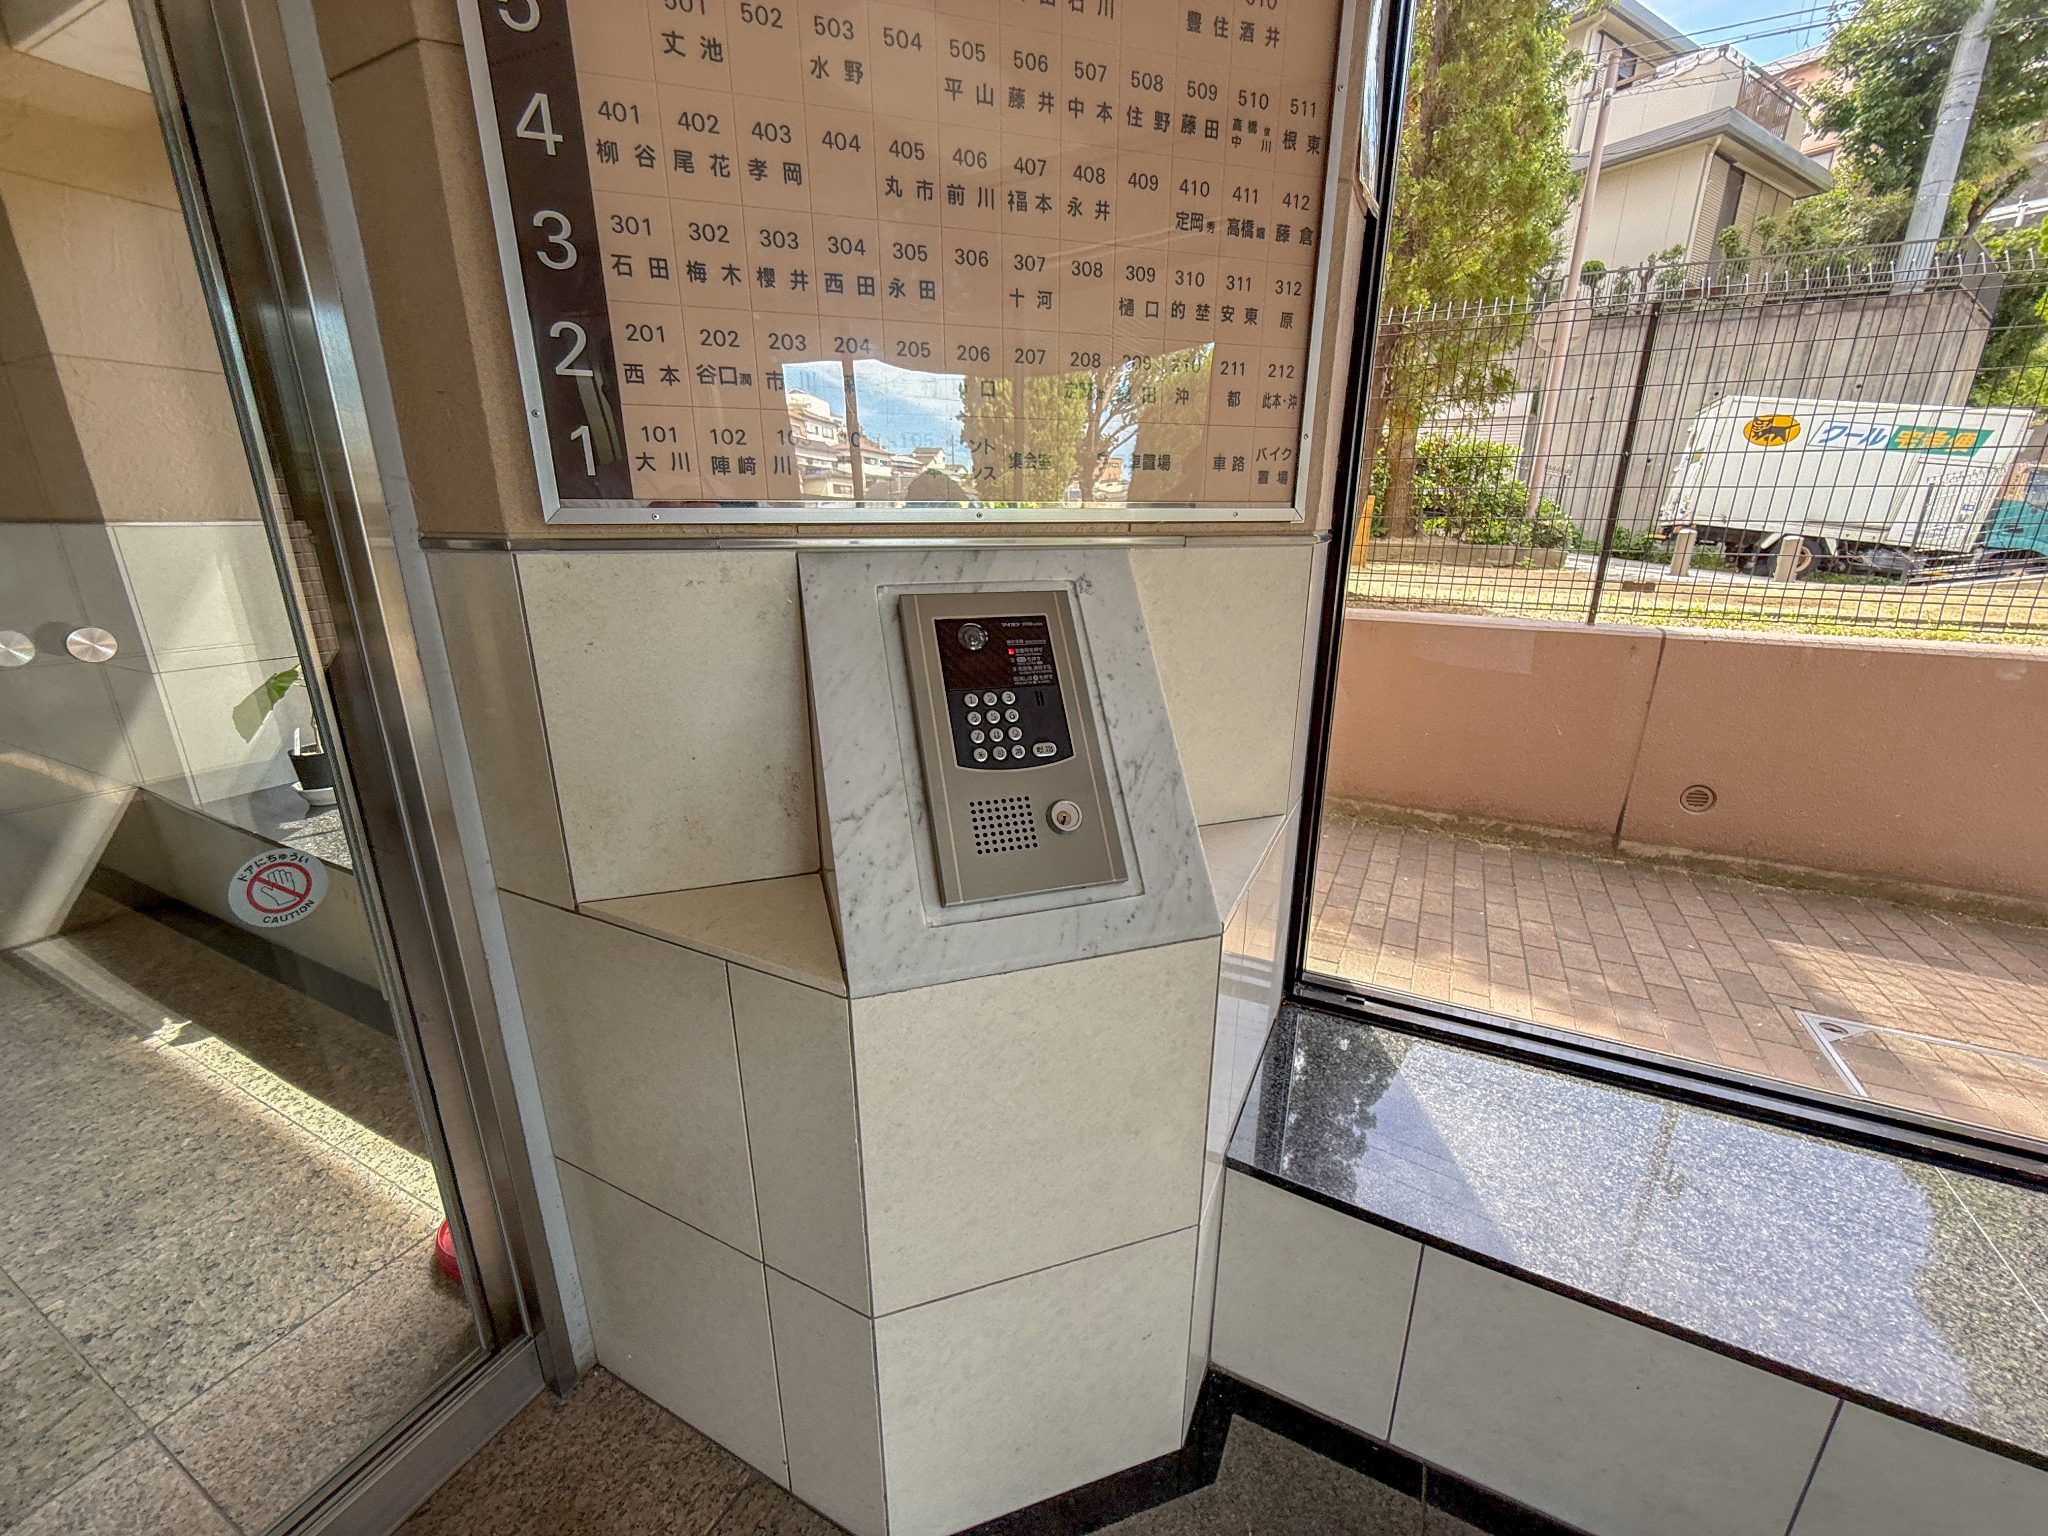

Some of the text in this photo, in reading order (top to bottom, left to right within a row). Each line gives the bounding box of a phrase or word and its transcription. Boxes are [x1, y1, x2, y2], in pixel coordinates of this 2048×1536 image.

[741, 3, 782, 28] 502
[814, 15, 854, 39] 503
[884, 27, 922, 51] 504
[950, 39, 985, 62] 505
[1014, 51, 1048, 72] 506
[1075, 61, 1106, 82] 507
[1132, 71, 1163, 92] 508
[1188, 81, 1217, 101] 509
[1239, 90, 1268, 110] 510
[1290, 99, 1315, 117] 511
[1240, 21, 1280, 48] 酒井
[515, 93, 563, 156] 4
[810, 56, 863, 84] 水野
[945, 78, 993, 106] 平山
[1008, 87, 1054, 114] 藤井
[1069, 98, 1112, 123] 中本
[1127, 105, 1170, 132] 住野
[1181, 114, 1218, 139] 藤田
[1283, 130, 1322, 156] 根東
[596, 139, 655, 168] 柳谷
[674, 149, 730, 177] 尾花
[748, 158, 801, 185] 孝岡
[885, 176, 933, 201] 丸市
[947, 184, 994, 209] 前川
[1008, 191, 1052, 213] 福本
[1068, 197, 1110, 221] 永井
[598, 101, 1309, 210] 401 402 403 404 405 406 407 408 409 410 411 412
[532, 211, 577, 270] 3
[611, 215, 1301, 296] 301 302 303 304 305 306 307 308 309 310 311 312
[611, 254, 669, 280] 石田
[686, 260, 741, 285] 梅木
[824, 273, 875, 296] 西田
[889, 278, 935, 300] 永田
[1010, 288, 1052, 309] 十河
[1221, 305, 1258, 325] 安東
[1280, 312, 1293, 329] 原
[549, 322, 593, 377] 2
[626, 324, 664, 342] 201
[700, 329, 739, 347] 202
[768, 333, 806, 351] 203
[834, 337, 868, 353] 204
[897, 341, 930, 358] 205
[958, 345, 989, 362] 206
[1015, 348, 1045, 364] 207
[1071, 352, 1100, 368] 208
[1221, 361, 1244, 376] 211
[1268, 364, 1294, 378] 212
[623, 364, 680, 386] 西本
[1228, 390, 1240, 407] 都
[571, 426, 596, 476] 1
[636, 452, 690, 472] 大川
[1213, 455, 1244, 472] 車路
[642, 426, 676, 442] 101
[710, 429, 746, 445] 102
[1256, 446, 1292, 462] バイク
[1257, 469, 1289, 485] 置場
[262, 899, 315, 924] CAUTION
